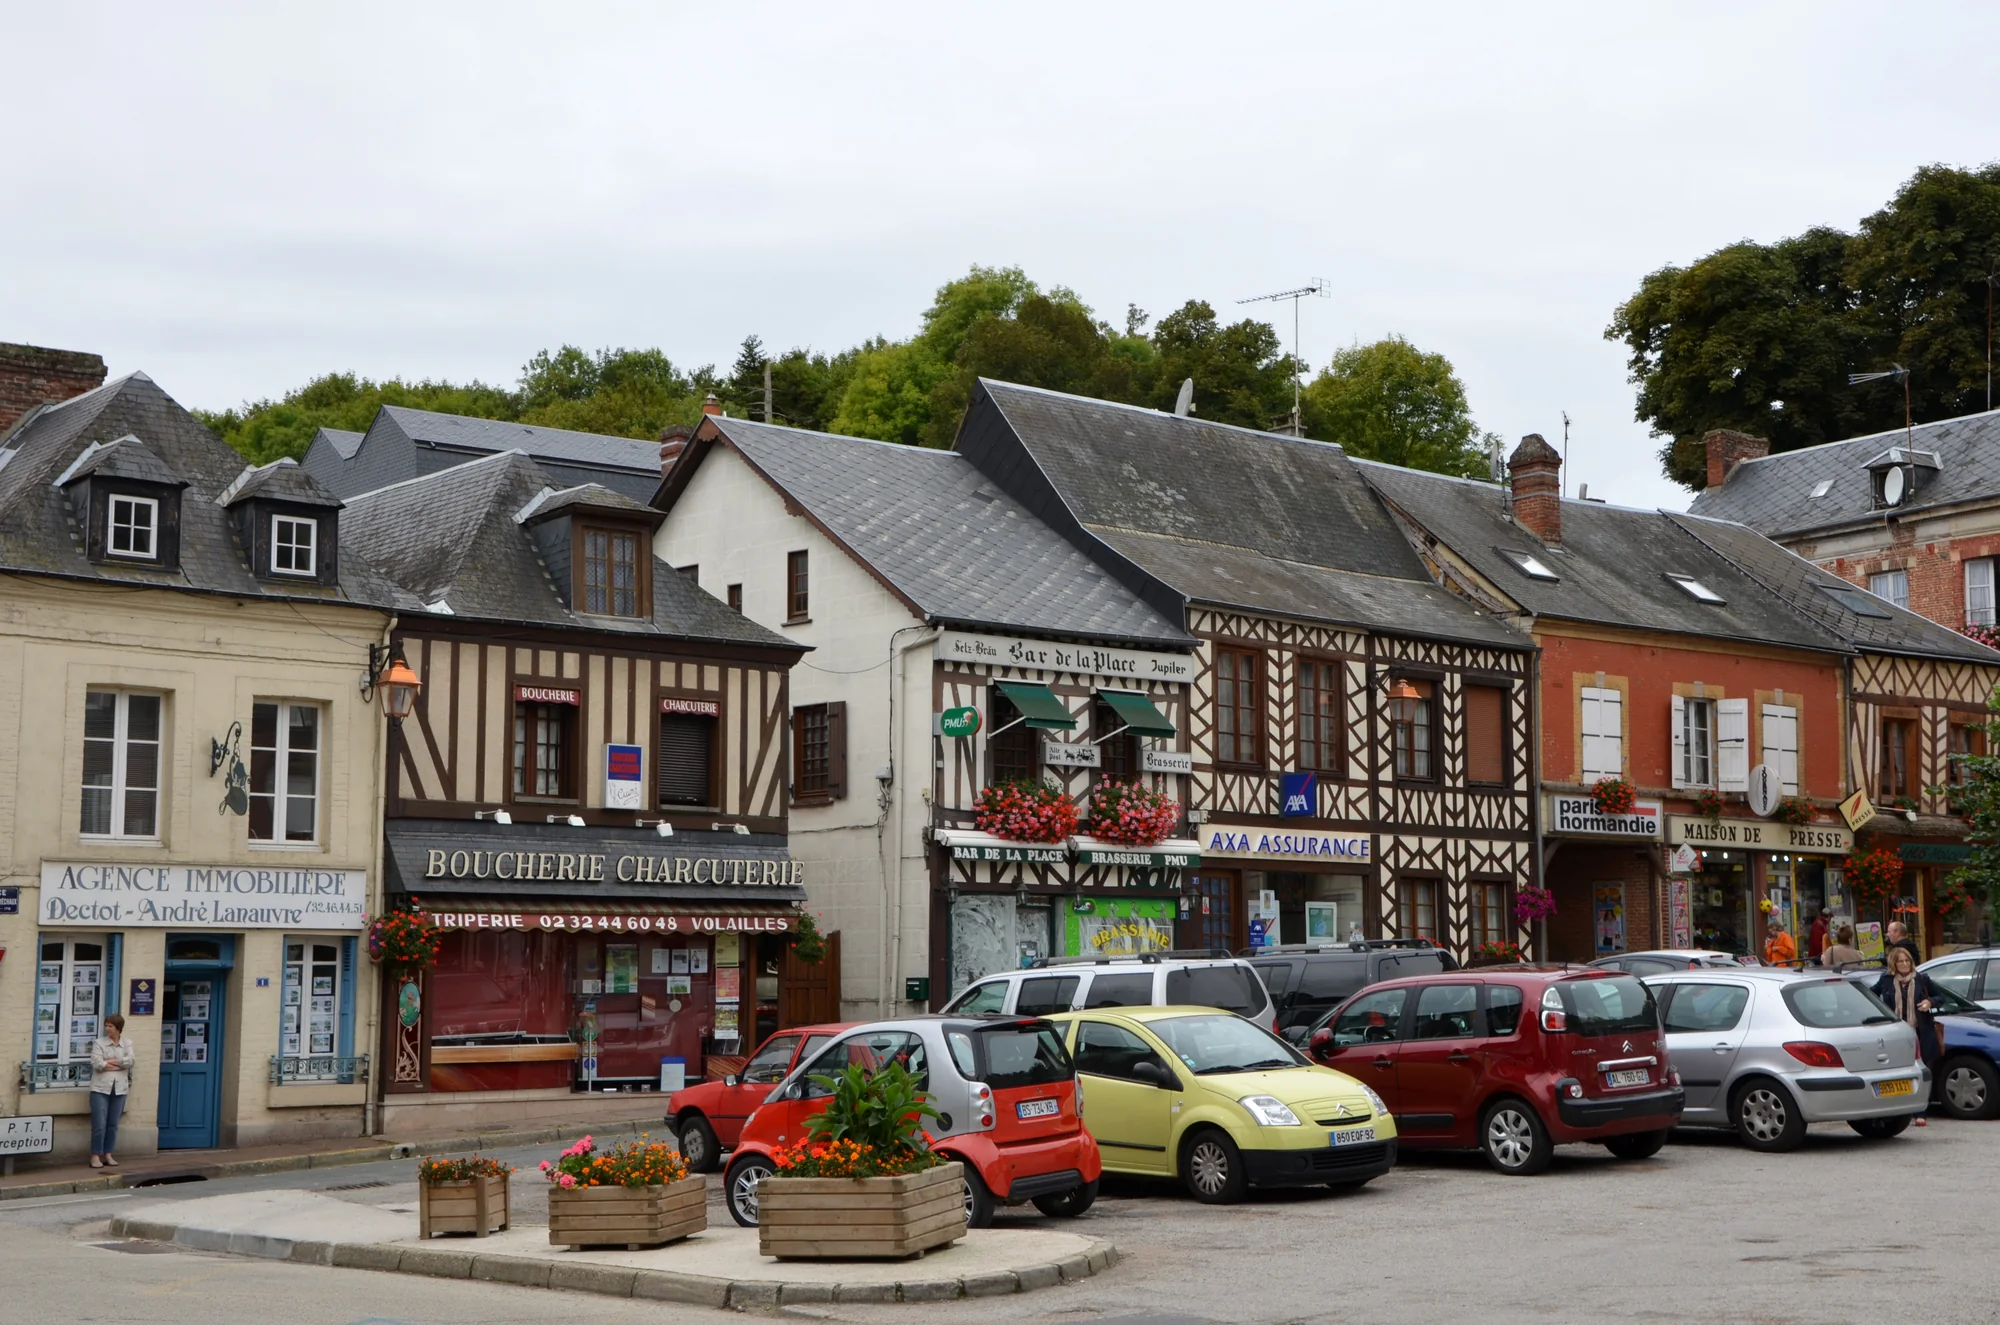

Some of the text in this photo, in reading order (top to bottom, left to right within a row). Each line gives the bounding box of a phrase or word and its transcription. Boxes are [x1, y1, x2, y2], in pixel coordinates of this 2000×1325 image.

[1008, 641, 1136, 673] Bar de la Place
[1151, 659, 1187, 676] Jupiler
[521, 687, 575, 702] BOUCHERIE
[663, 699, 718, 714] CHARCUTERIE
[943, 717, 963, 729] PMU
[1146, 752, 1189, 769] Brasserie
[1284, 794, 1308, 812] AXA
[1560, 799, 1604, 816] paris
[1560, 814, 1656, 834] normandie
[1851, 808, 1872, 827] PRESSE
[1210, 832, 1370, 857] AXA ASSURANCE
[1684, 823, 1842, 848] MAISON DE PRESSE
[954, 847, 1064, 862] BAR DE LA PLACE
[1092, 852, 1188, 866] BRASSERIE PMU
[425, 849, 805, 886] BOUCHERIE CHARCUTERIE
[58, 865, 170, 892] AGENCE
[46, 897, 122, 921] Dectot
[212, 900, 303, 924] Lanauvre
[432, 912, 788, 931] TRIPERIE 02 32 44 60 48 VOLAILLES
[1091, 923, 1170, 949] BRASSERIE
